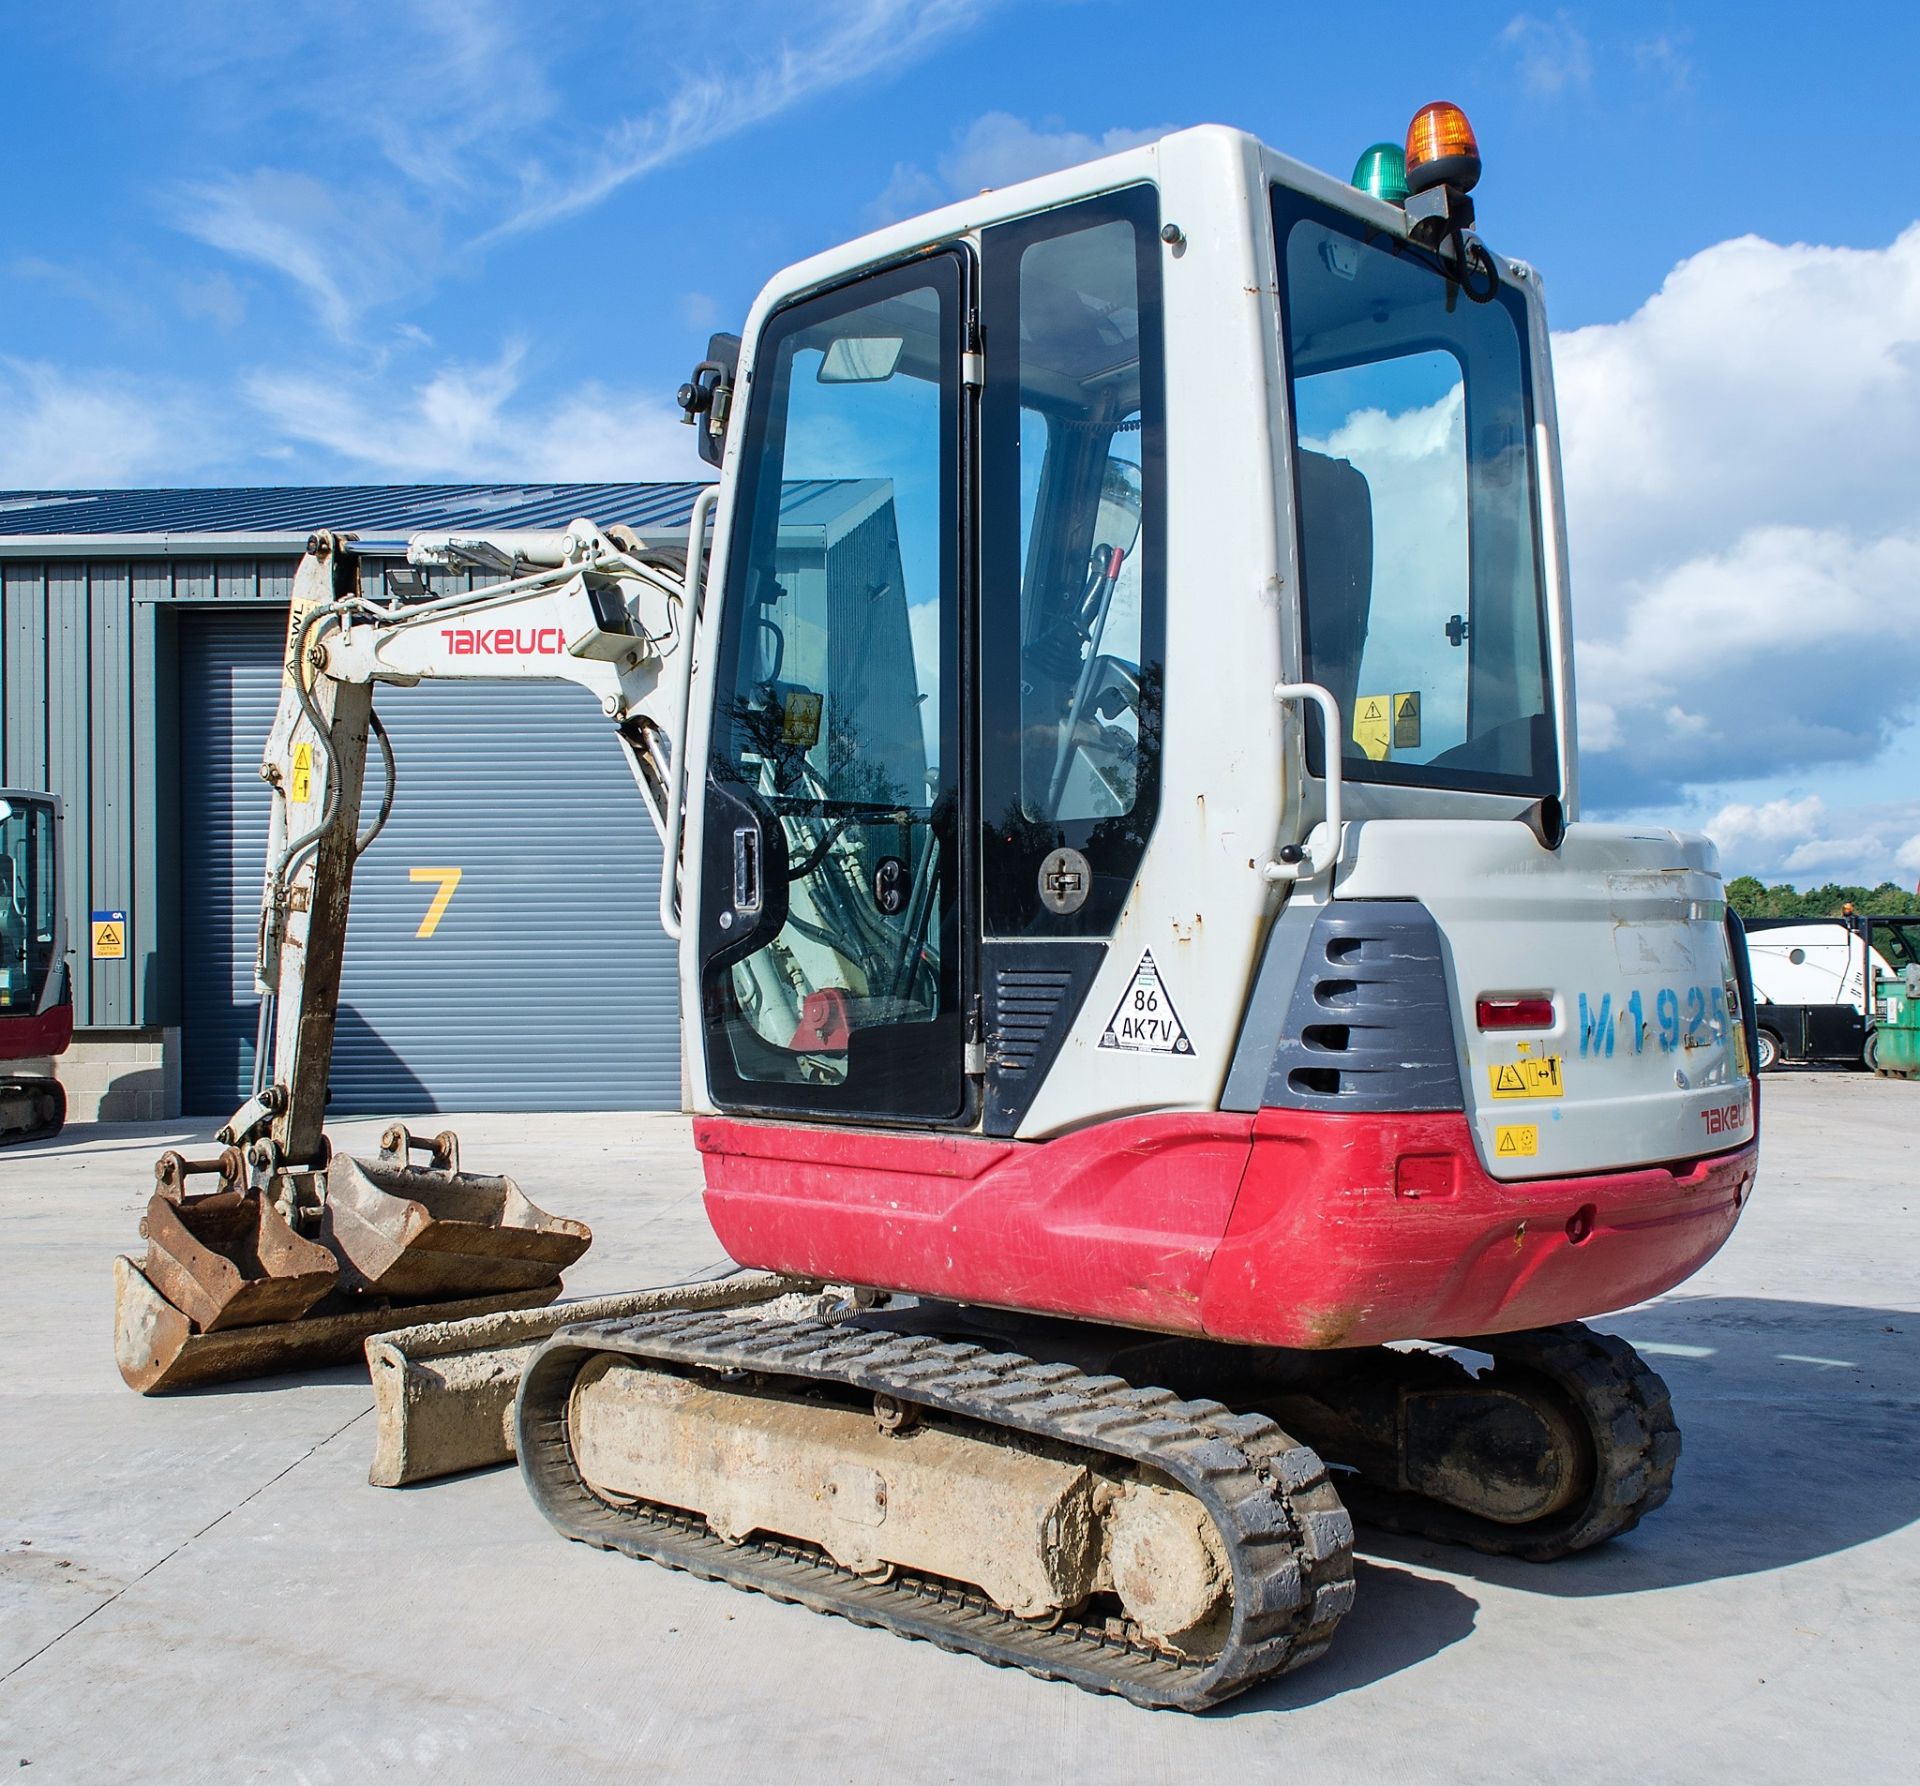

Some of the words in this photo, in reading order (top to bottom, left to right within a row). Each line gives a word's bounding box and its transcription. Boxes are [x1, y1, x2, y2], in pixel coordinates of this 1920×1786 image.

[409, 867, 463, 939] 7
[1133, 989, 1158, 1012] 86
[1121, 1017, 1173, 1042] AK7V
